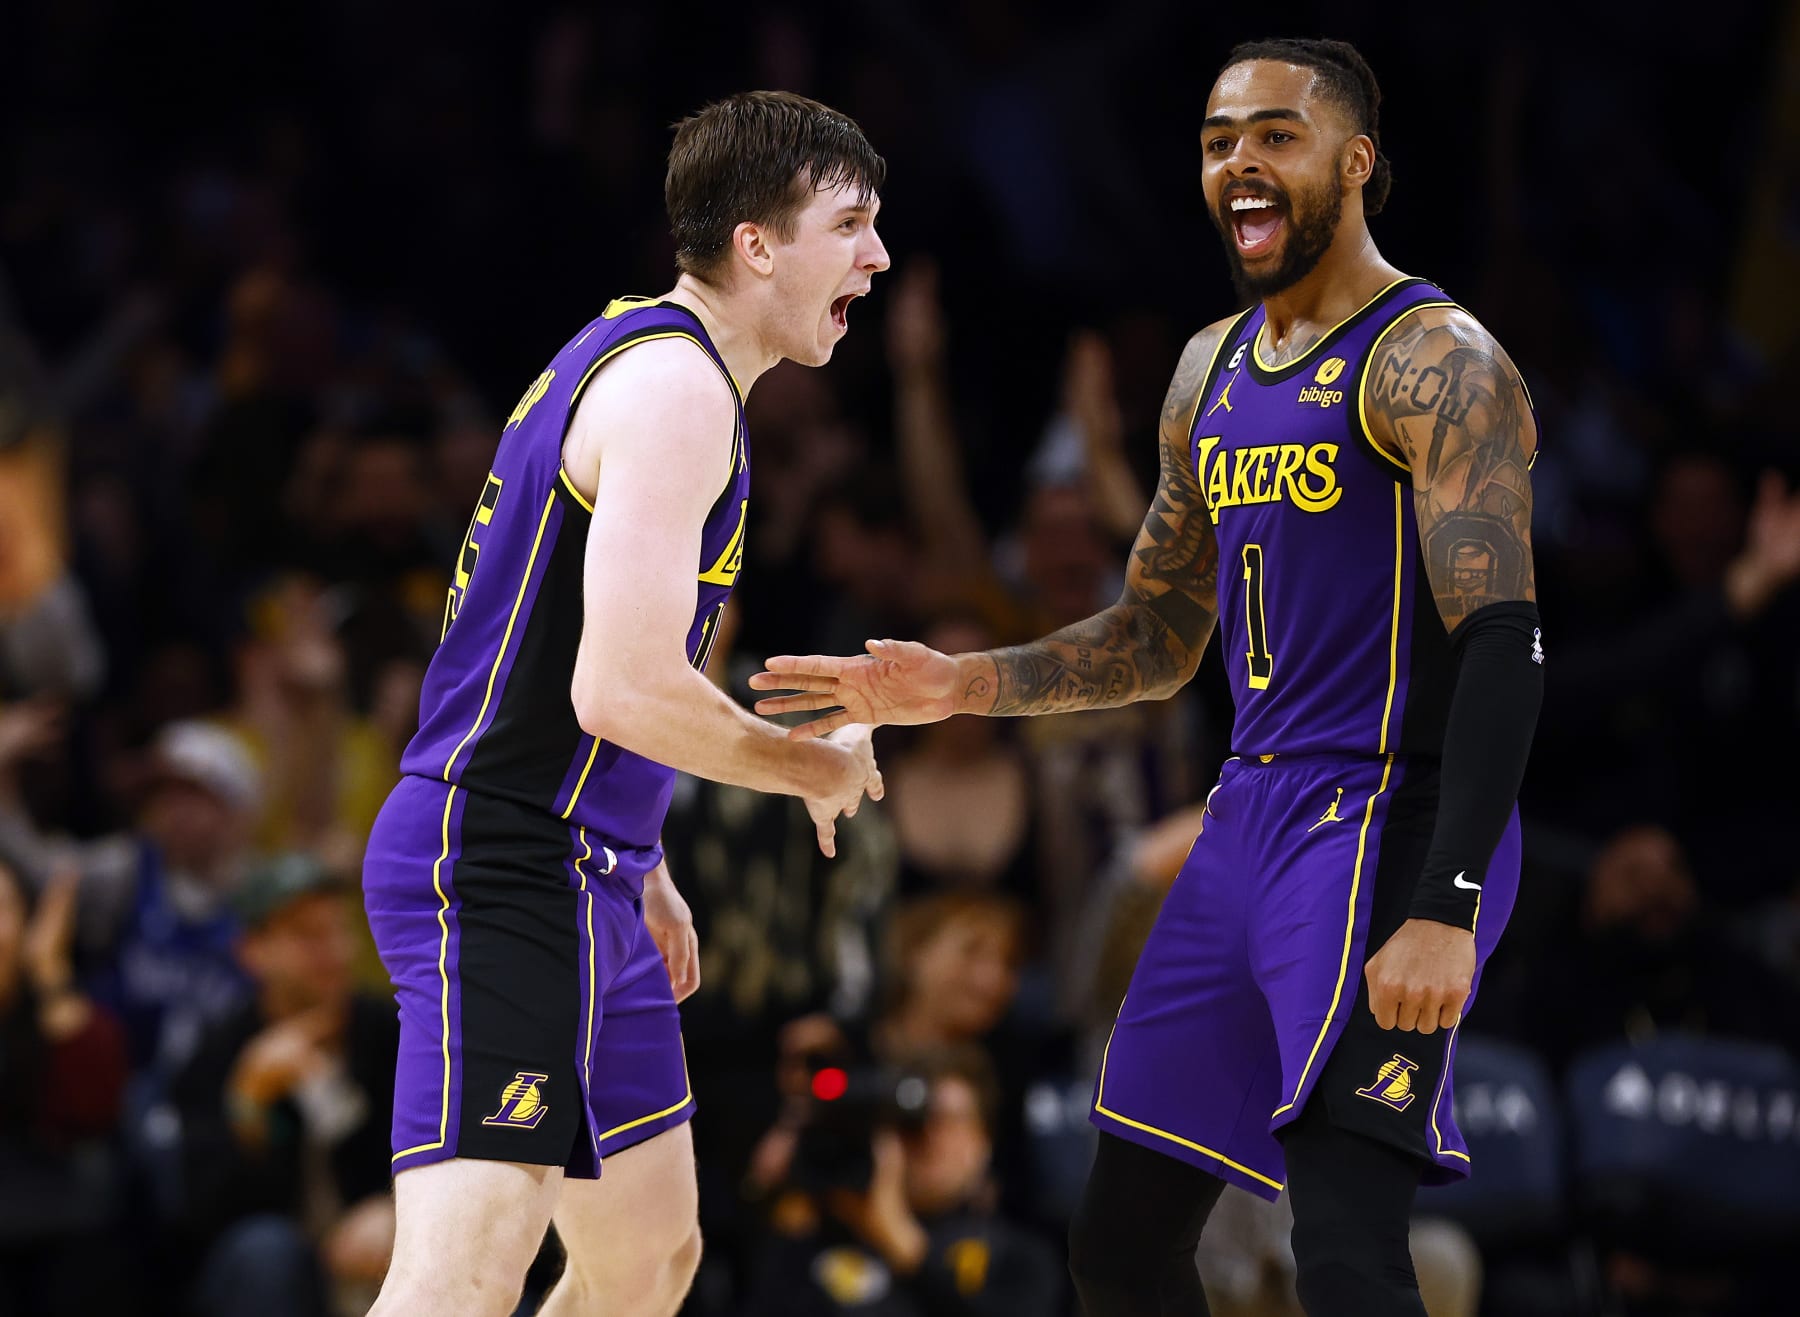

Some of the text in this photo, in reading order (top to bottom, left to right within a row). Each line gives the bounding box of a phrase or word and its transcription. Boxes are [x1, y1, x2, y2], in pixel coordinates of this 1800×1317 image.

[1227, 342, 1249, 369] 6
[1297, 386, 1344, 409] bibigo
[1196, 435, 1343, 525] LAKERS
[1242, 543, 1273, 692] 1
